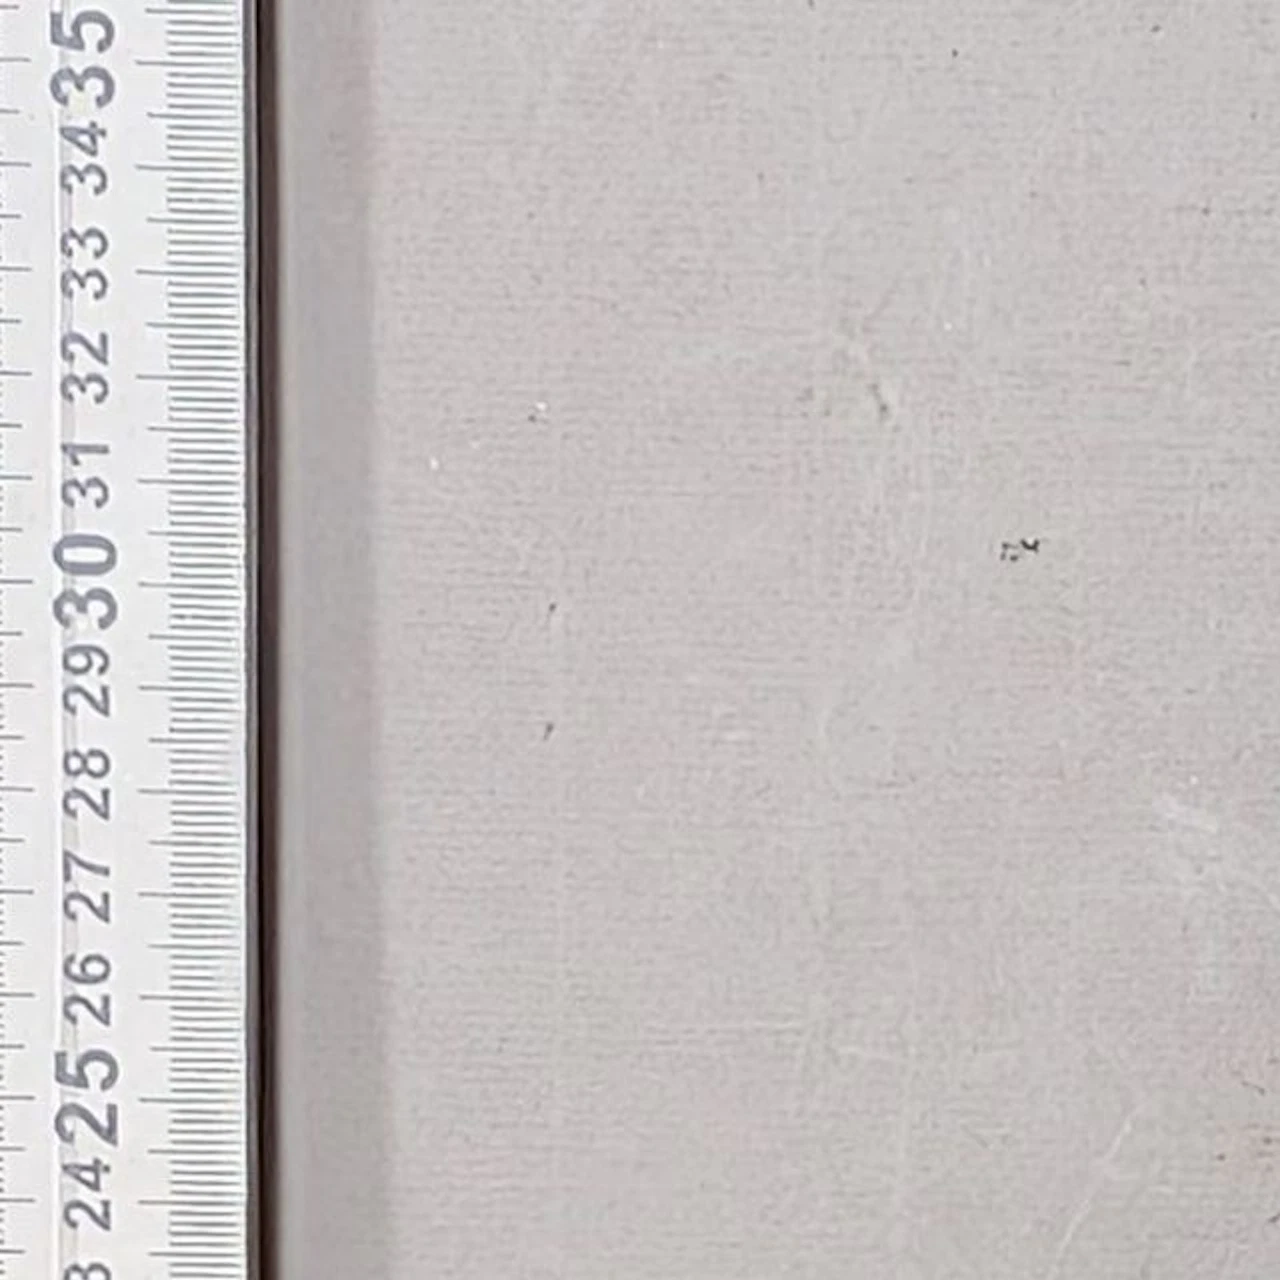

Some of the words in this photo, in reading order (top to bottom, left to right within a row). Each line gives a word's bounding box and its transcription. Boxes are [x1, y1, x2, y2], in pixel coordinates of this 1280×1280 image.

[50, 8, 116, 110] 35
[58, 119, 109, 197] 34
[59, 223, 110, 303] 33
[59, 329, 110, 405] 32
[59, 441, 110, 511] 31
[52, 532, 118, 632] 30
[60, 643, 111, 719] 29
[60, 747, 111, 822] 28
[60, 849, 111, 925] 27
[61, 951, 112, 1028] 26
[53, 1048, 119, 1148] 25
[61, 1156, 112, 1233] 24
